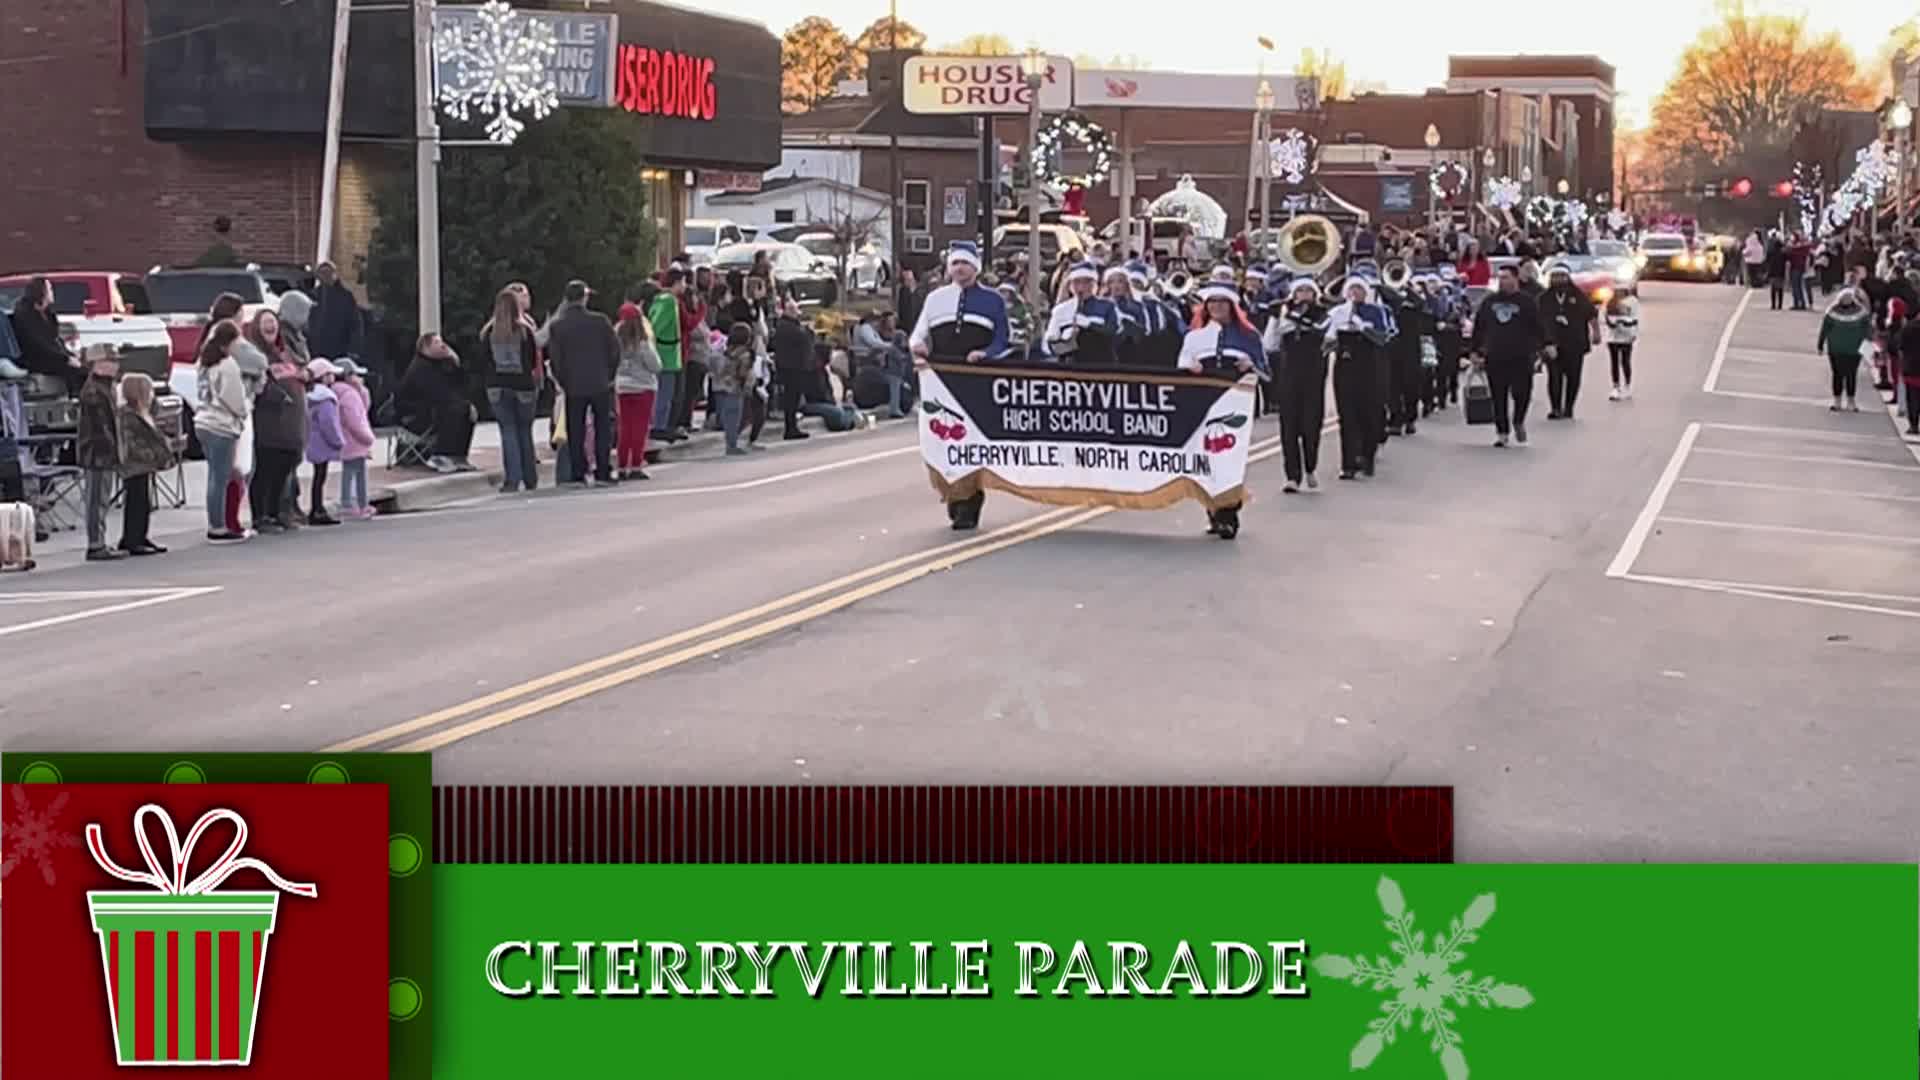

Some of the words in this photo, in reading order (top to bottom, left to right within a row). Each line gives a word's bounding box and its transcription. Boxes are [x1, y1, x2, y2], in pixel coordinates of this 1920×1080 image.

[662, 51, 715, 120] DRUG
[992, 378, 1176, 411] CHERRYVILLE
[1003, 409, 1040, 432] HIGH
[1049, 411, 1114, 434] SCHOOL
[1123, 414, 1168, 437] BAND
[1075, 447, 1129, 471] NORTH
